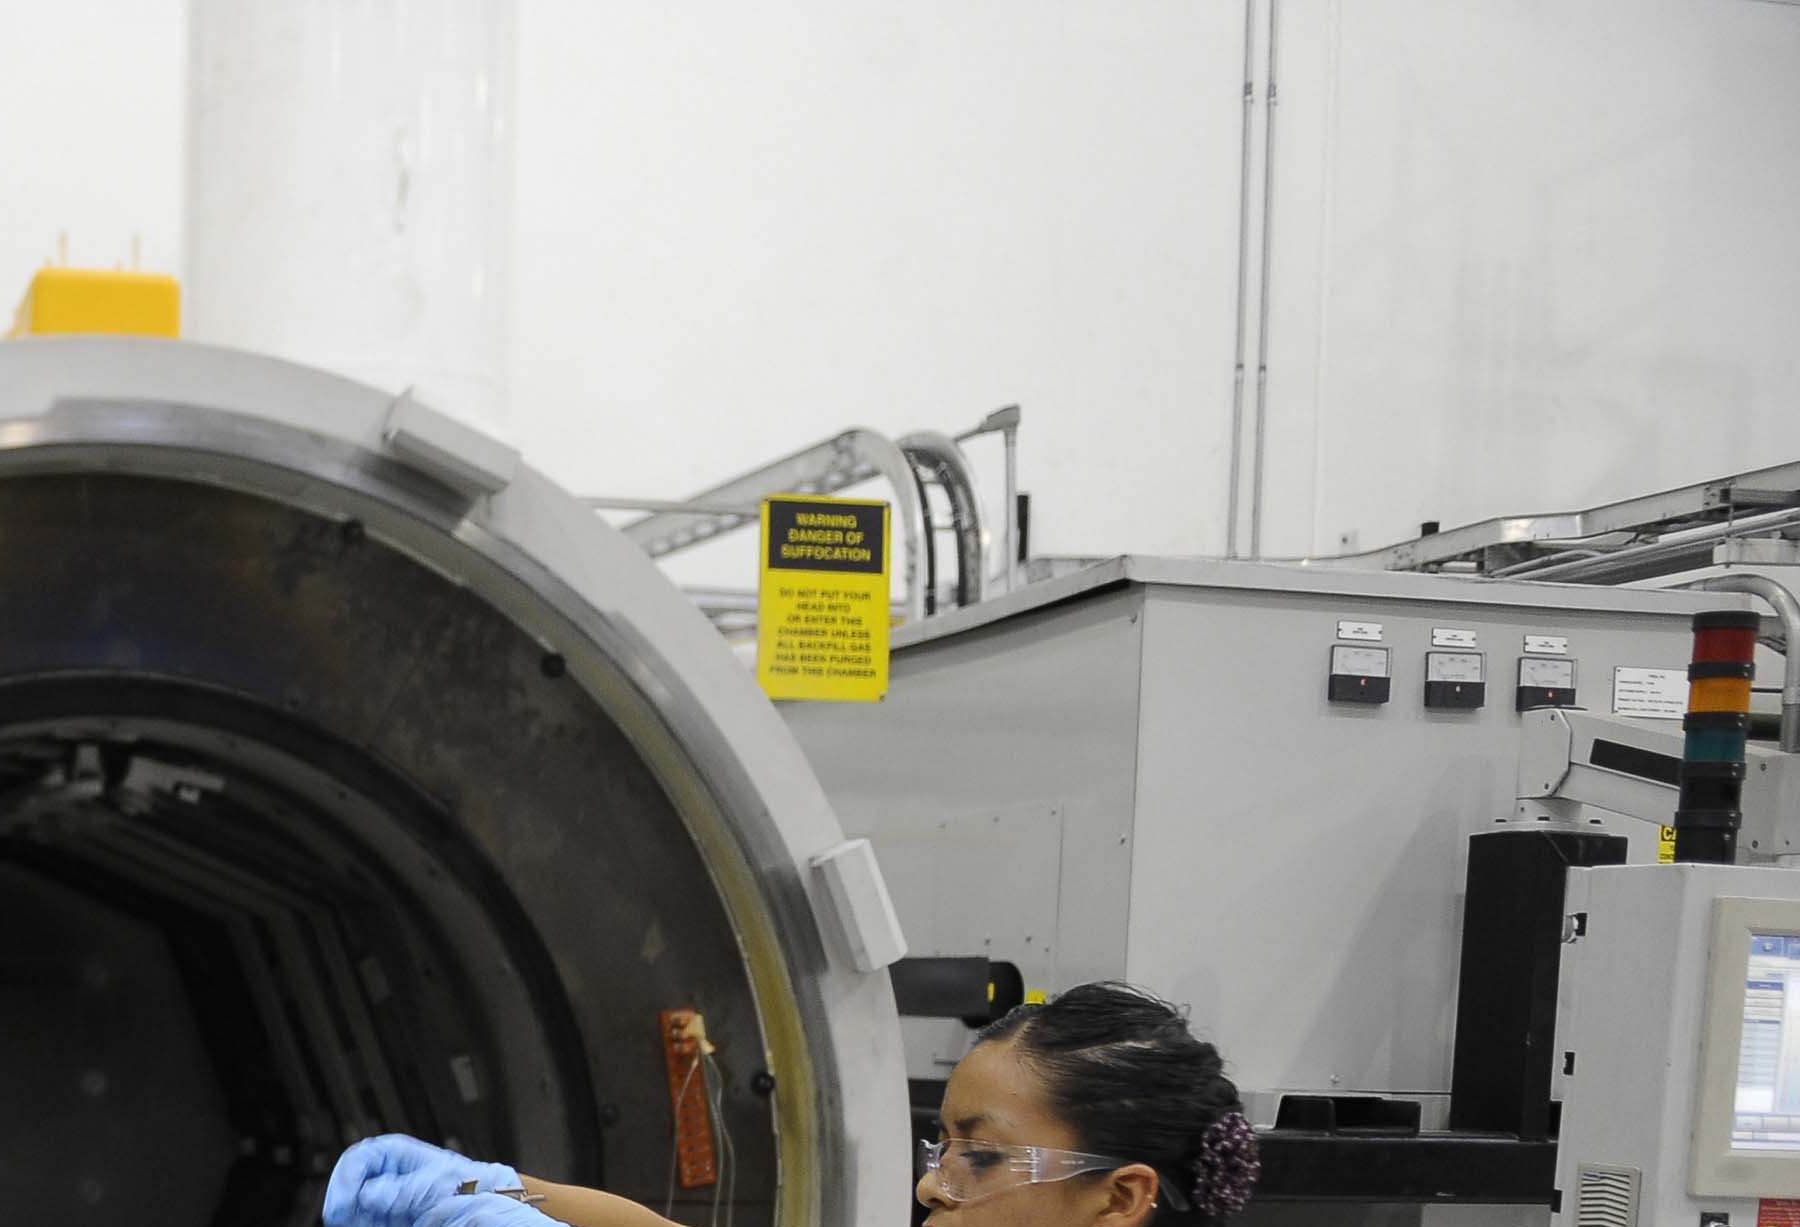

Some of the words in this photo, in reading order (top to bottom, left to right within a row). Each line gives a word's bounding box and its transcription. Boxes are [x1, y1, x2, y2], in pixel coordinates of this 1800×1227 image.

[795, 512, 857, 528] WARNING
[788, 528, 843, 544] DANGER
[845, 531, 864, 545] OF
[781, 544, 871, 562] SUFFOCATION
[780, 588, 793, 597] DO
[797, 589, 816, 598] NOT
[821, 590, 839, 599] PUT
[844, 591, 871, 600] YOUR
[797, 602, 824, 611] HEAD
[827, 603, 851, 612] INTO
[787, 614, 801, 624] OR
[805, 615, 837, 625] ENTER
[841, 616, 862, 626] THIS
[778, 627, 828, 637] CHAMBER
[777, 641, 794, 649] ALL
[850, 644, 871, 652] GAS
[776, 653, 795, 662] HAS
[800, 654, 826, 663] BEEN
[770, 666, 799, 675] FROM
[802, 667, 823, 676] THIS
[826, 669, 877, 678] CHAMBER
